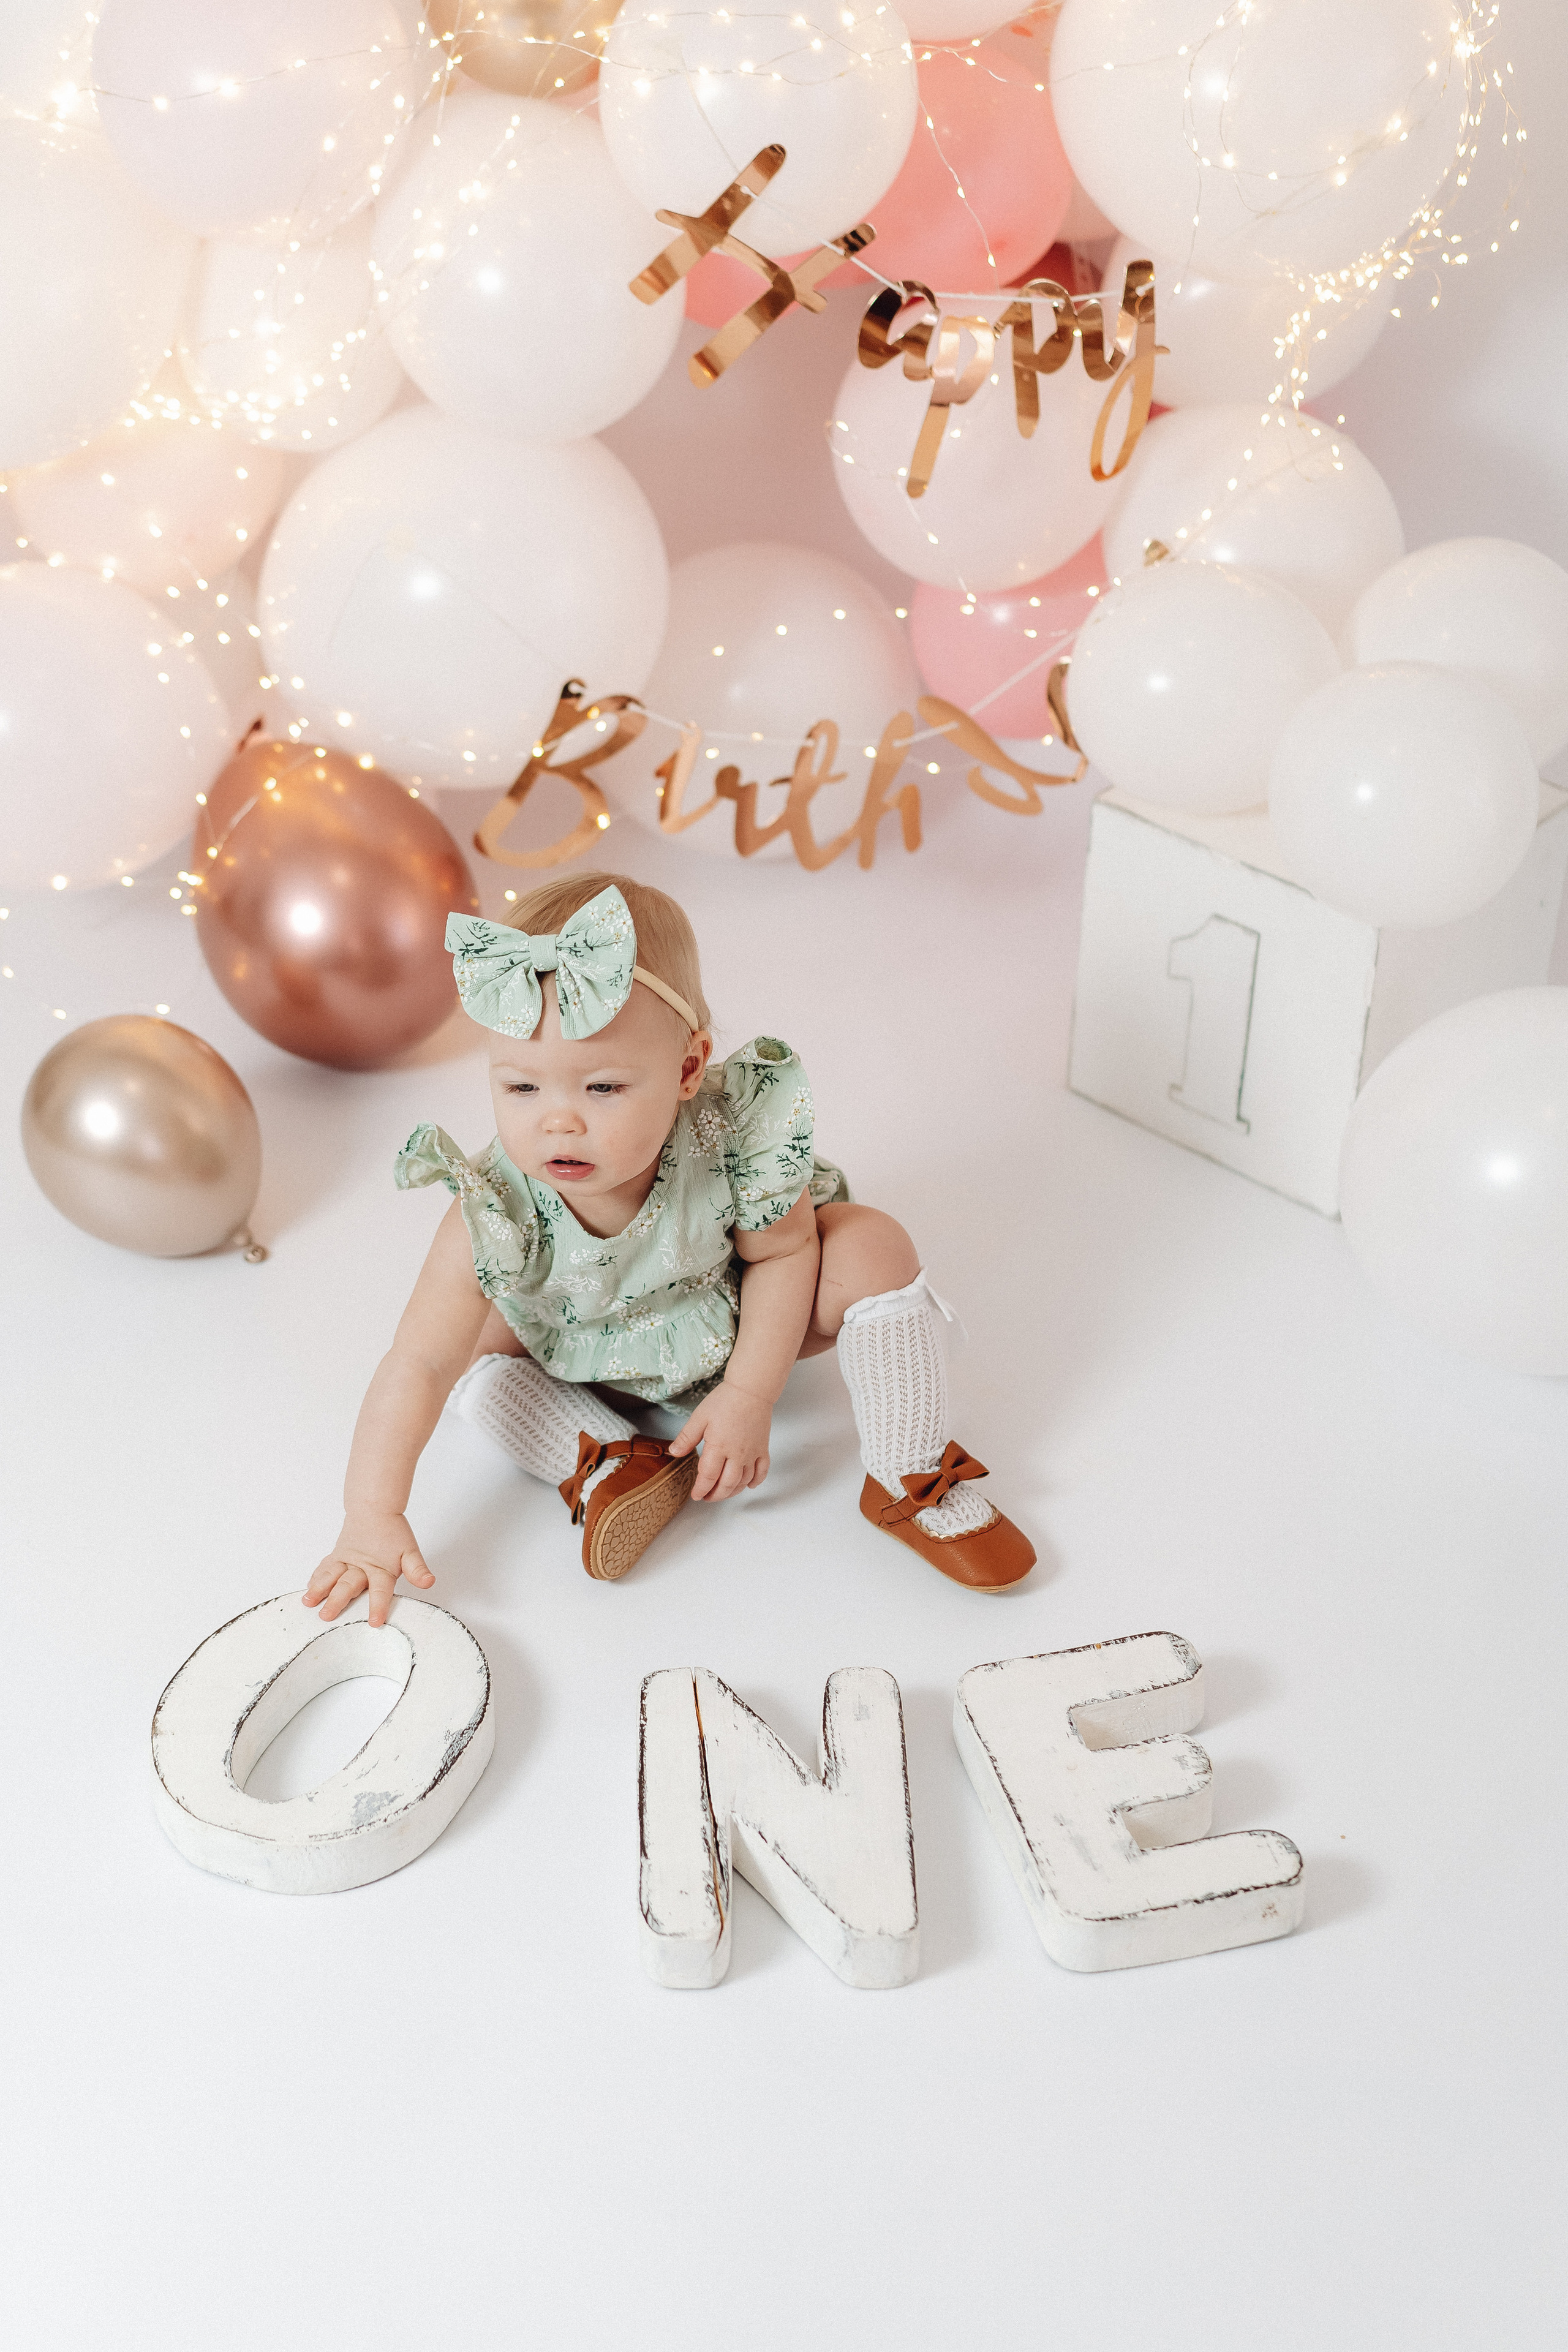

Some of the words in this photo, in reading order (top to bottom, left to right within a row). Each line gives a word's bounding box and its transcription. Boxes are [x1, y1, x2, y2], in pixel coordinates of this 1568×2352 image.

[629, 143, 1170, 498] Happy
[1166, 912, 1261, 1136] 1
[151, 1589, 1306, 1991] ONE
